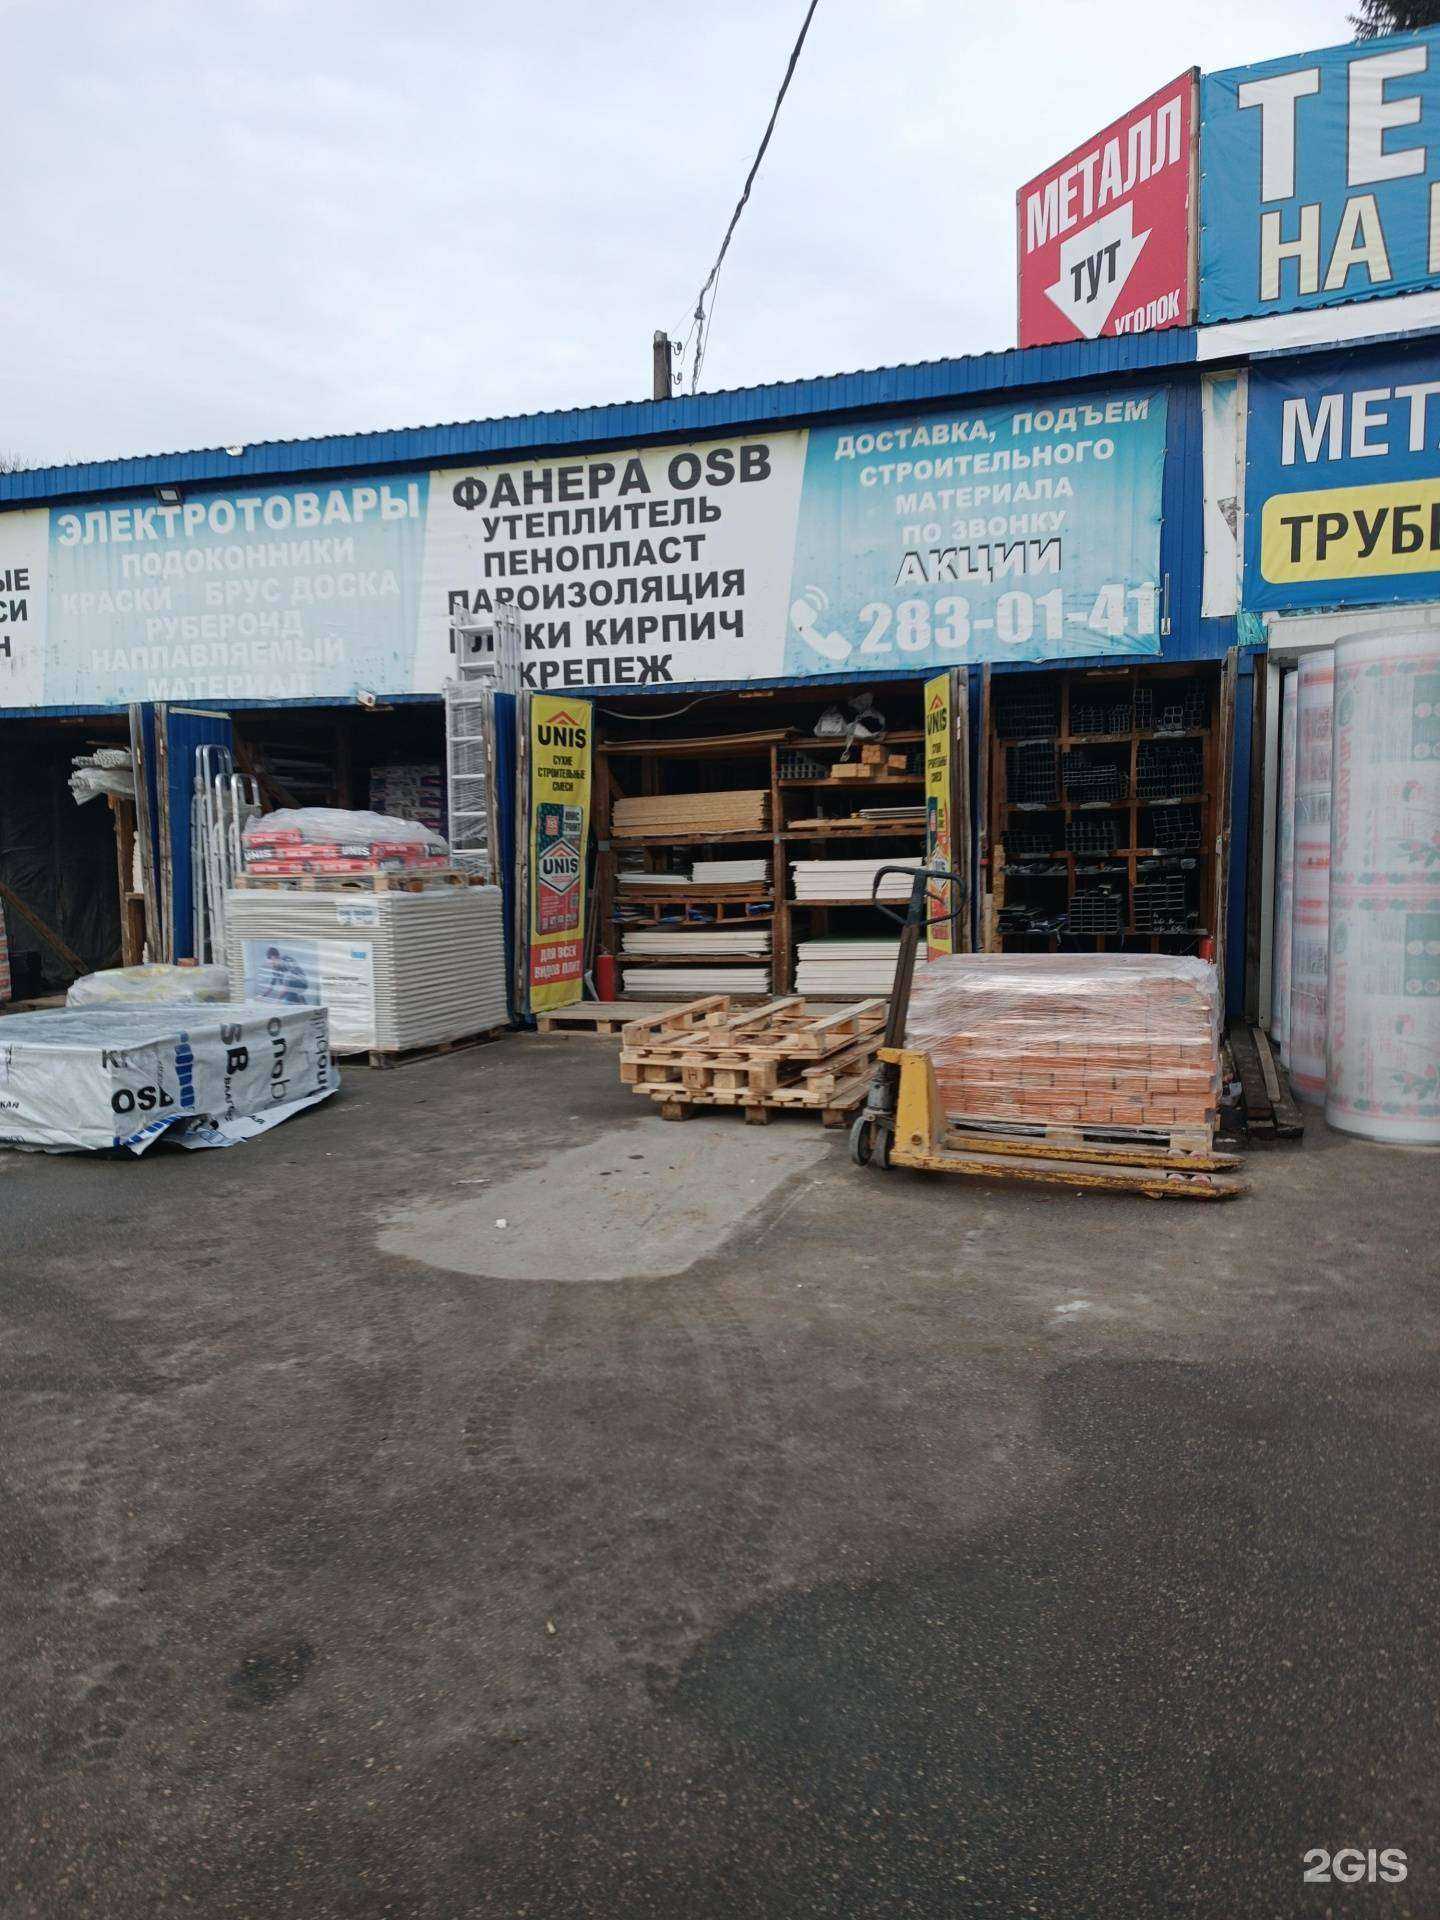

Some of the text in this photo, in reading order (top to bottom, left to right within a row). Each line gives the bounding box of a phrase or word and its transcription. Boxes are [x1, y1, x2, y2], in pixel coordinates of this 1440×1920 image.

[1026, 95, 1182, 255] МЕТАЛЛ
[1070, 239, 1121, 303] ТУТ
[1258, 194, 1392, 302] НА
[1115, 288, 1181, 336] УГОЛОК
[834, 399, 1150, 461] ДОСТАВКА, ПОДЪЕМ
[1281, 380, 1440, 467] МЕТ
[452, 443, 772, 511] ФАНЕРА OSB
[859, 438, 1115, 488] СТРОИТЕЛЬНОГО
[57, 482, 420, 546] ЭЛЕКТРОТОВАРЫ
[481, 496, 723, 542] УТЕПЛИТЕЛЬ
[896, 476, 1074, 516] МАТЕРИАЛА
[902, 510, 1067, 546] ПО ЗВОНКУ
[121, 537, 355, 579] ПОДОКОННИКИ
[483, 534, 707, 578] ПЕНОПЛАСТ
[894, 537, 1062, 586] АКЦИИ
[61, 569, 401, 616] КРАСКИ БРУС ДОСКА
[448, 568, 746, 616] ПАРОИЗОЛЯЦИЯ
[585, 609, 745, 648] КИРПИЧ
[858, 580, 1156, 655] 283-01-41
[90, 634, 345, 673] НАПЛАВЛЯЕМЫЙ
[519, 654, 674, 689] КРЕПЕЖ
[147, 672, 312, 701] МАТЕРИАЛ
[537, 724, 587, 749] UNIS
[927, 707, 947, 736] UNIS
[542, 857, 578, 875] UNIS
